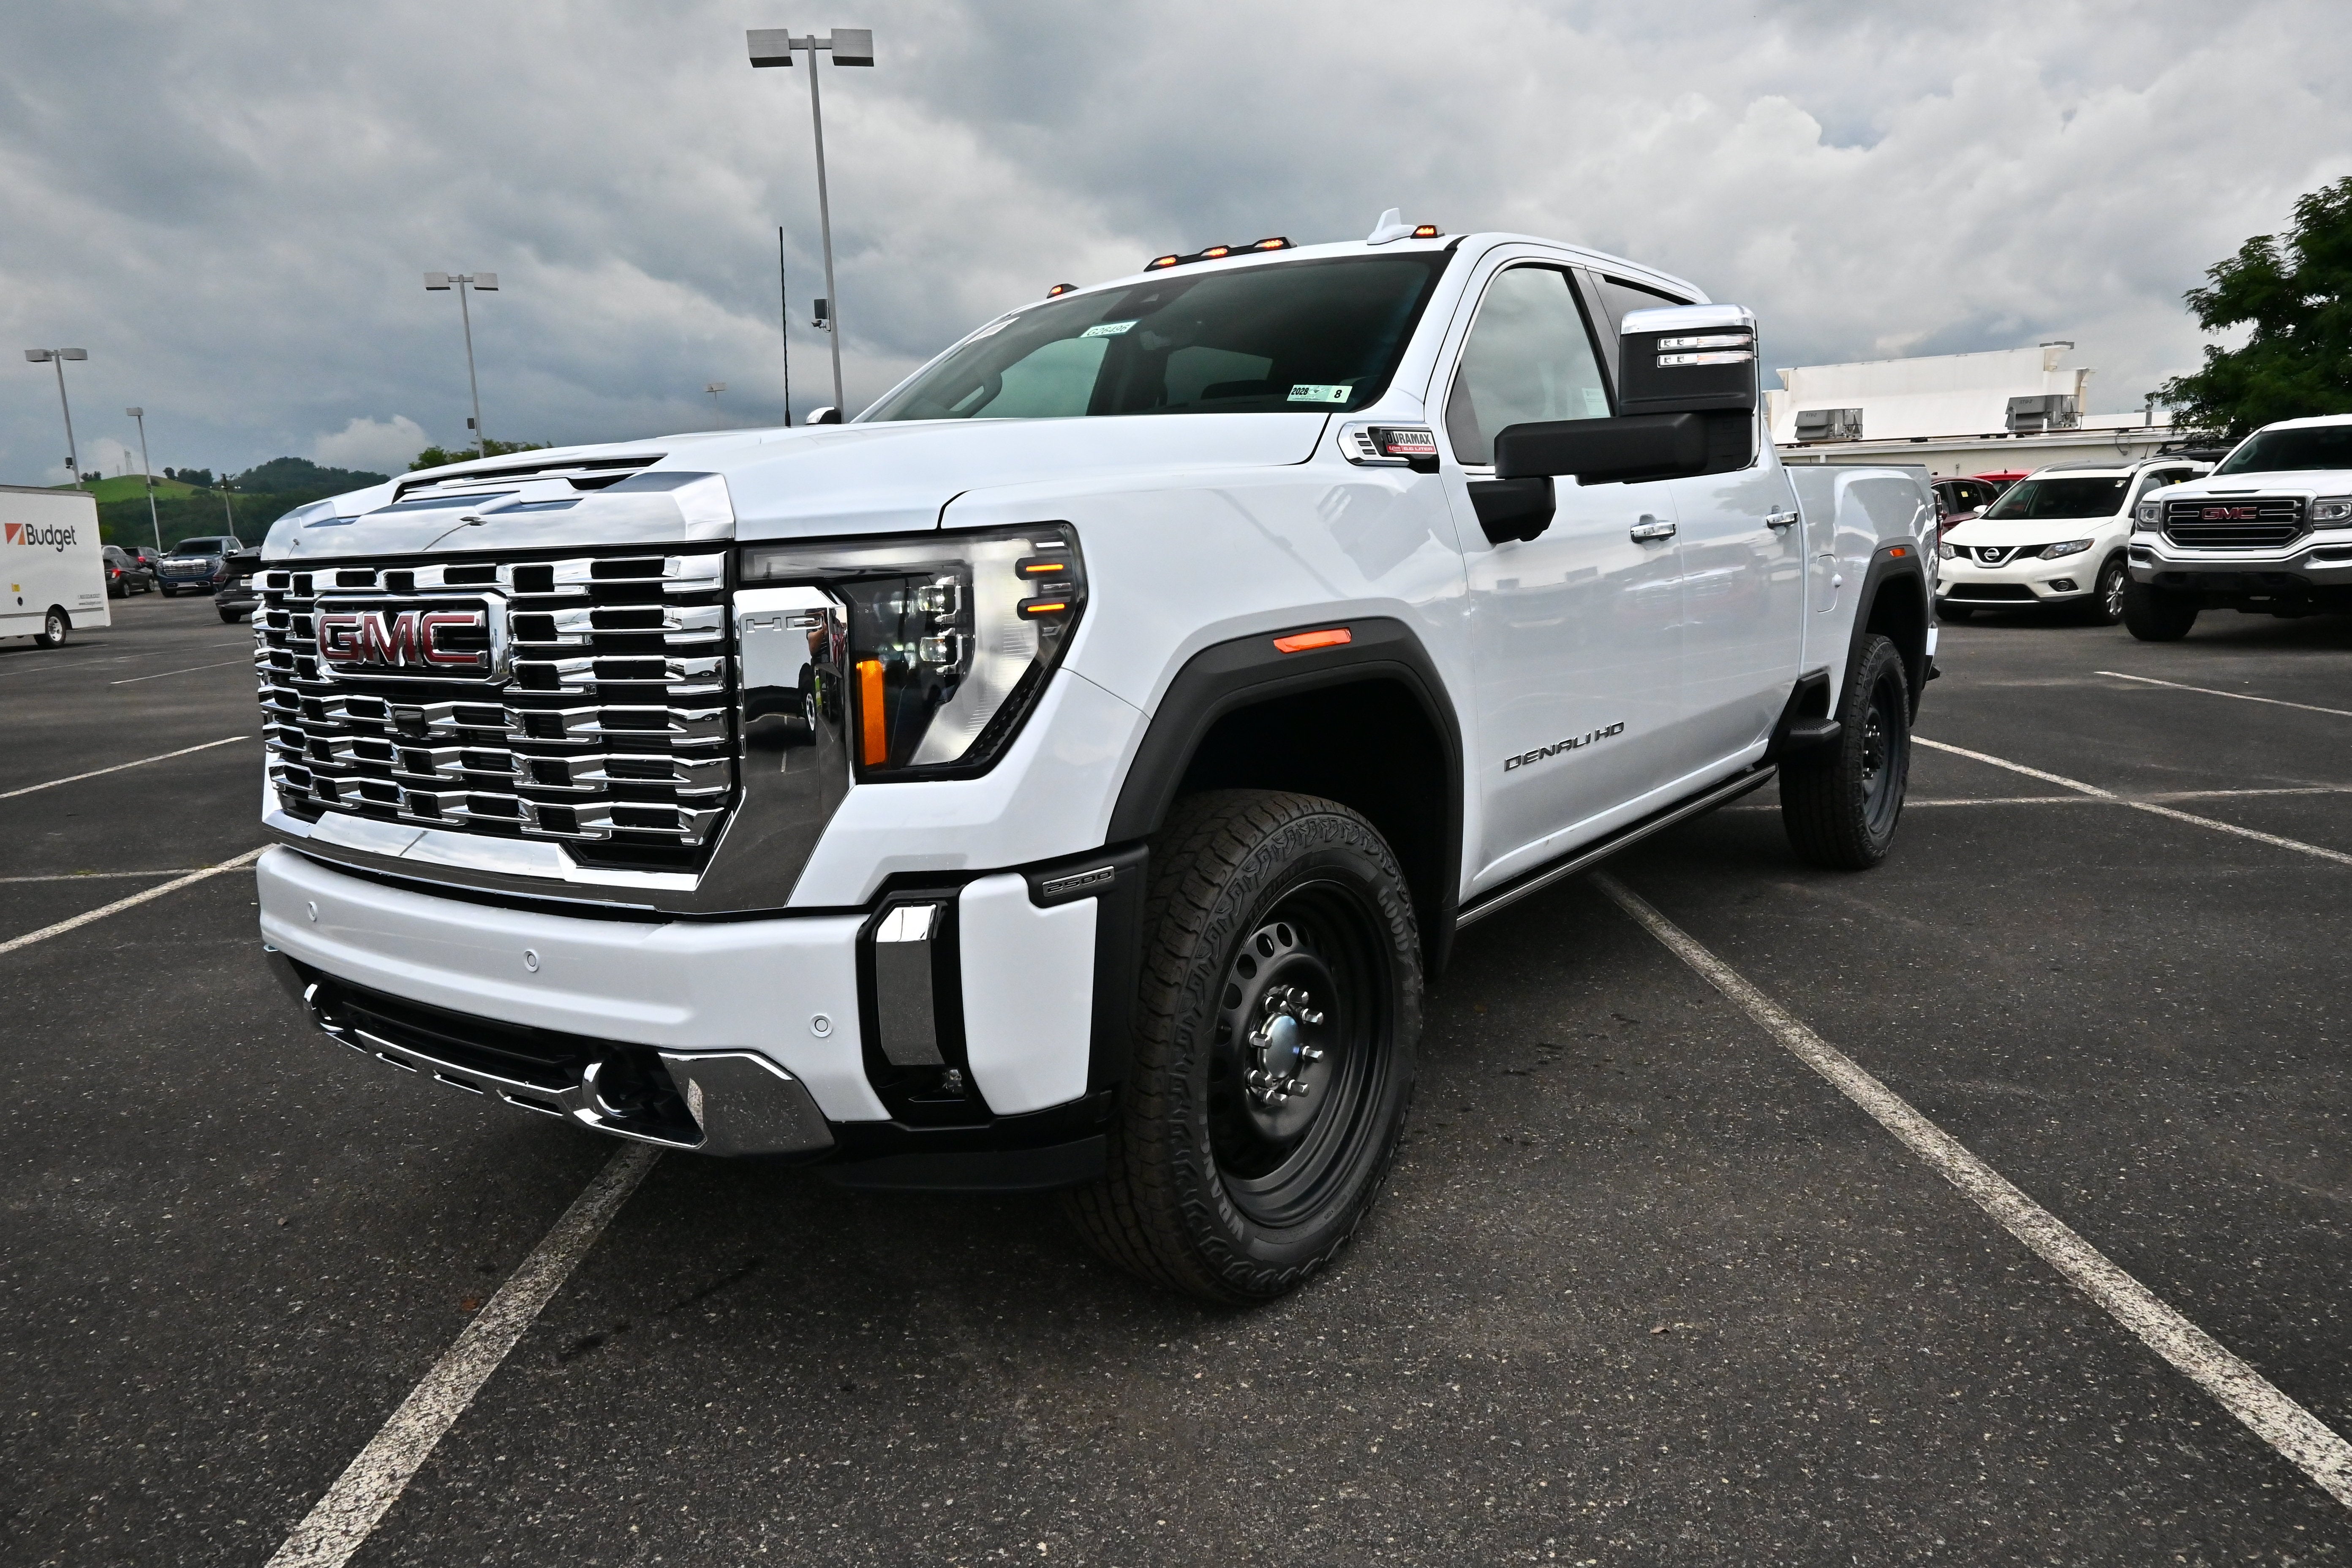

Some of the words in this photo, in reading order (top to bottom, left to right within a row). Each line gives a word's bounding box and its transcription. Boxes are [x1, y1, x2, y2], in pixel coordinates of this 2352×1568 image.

[1086, 324, 1130, 336] G26496
[1291, 387, 1309, 395] 2028
[1334, 389, 1342, 398] 8
[1386, 433, 1432, 444] DURAMAX
[2202, 507, 2257, 520] GMC
[25, 523, 77, 553] Budget
[746, 615, 823, 633] HD
[319, 610, 488, 668] GMC
[1504, 732, 1591, 772] DENALI
[1594, 721, 1625, 742] HD
[1047, 871, 1112, 894] 2500
